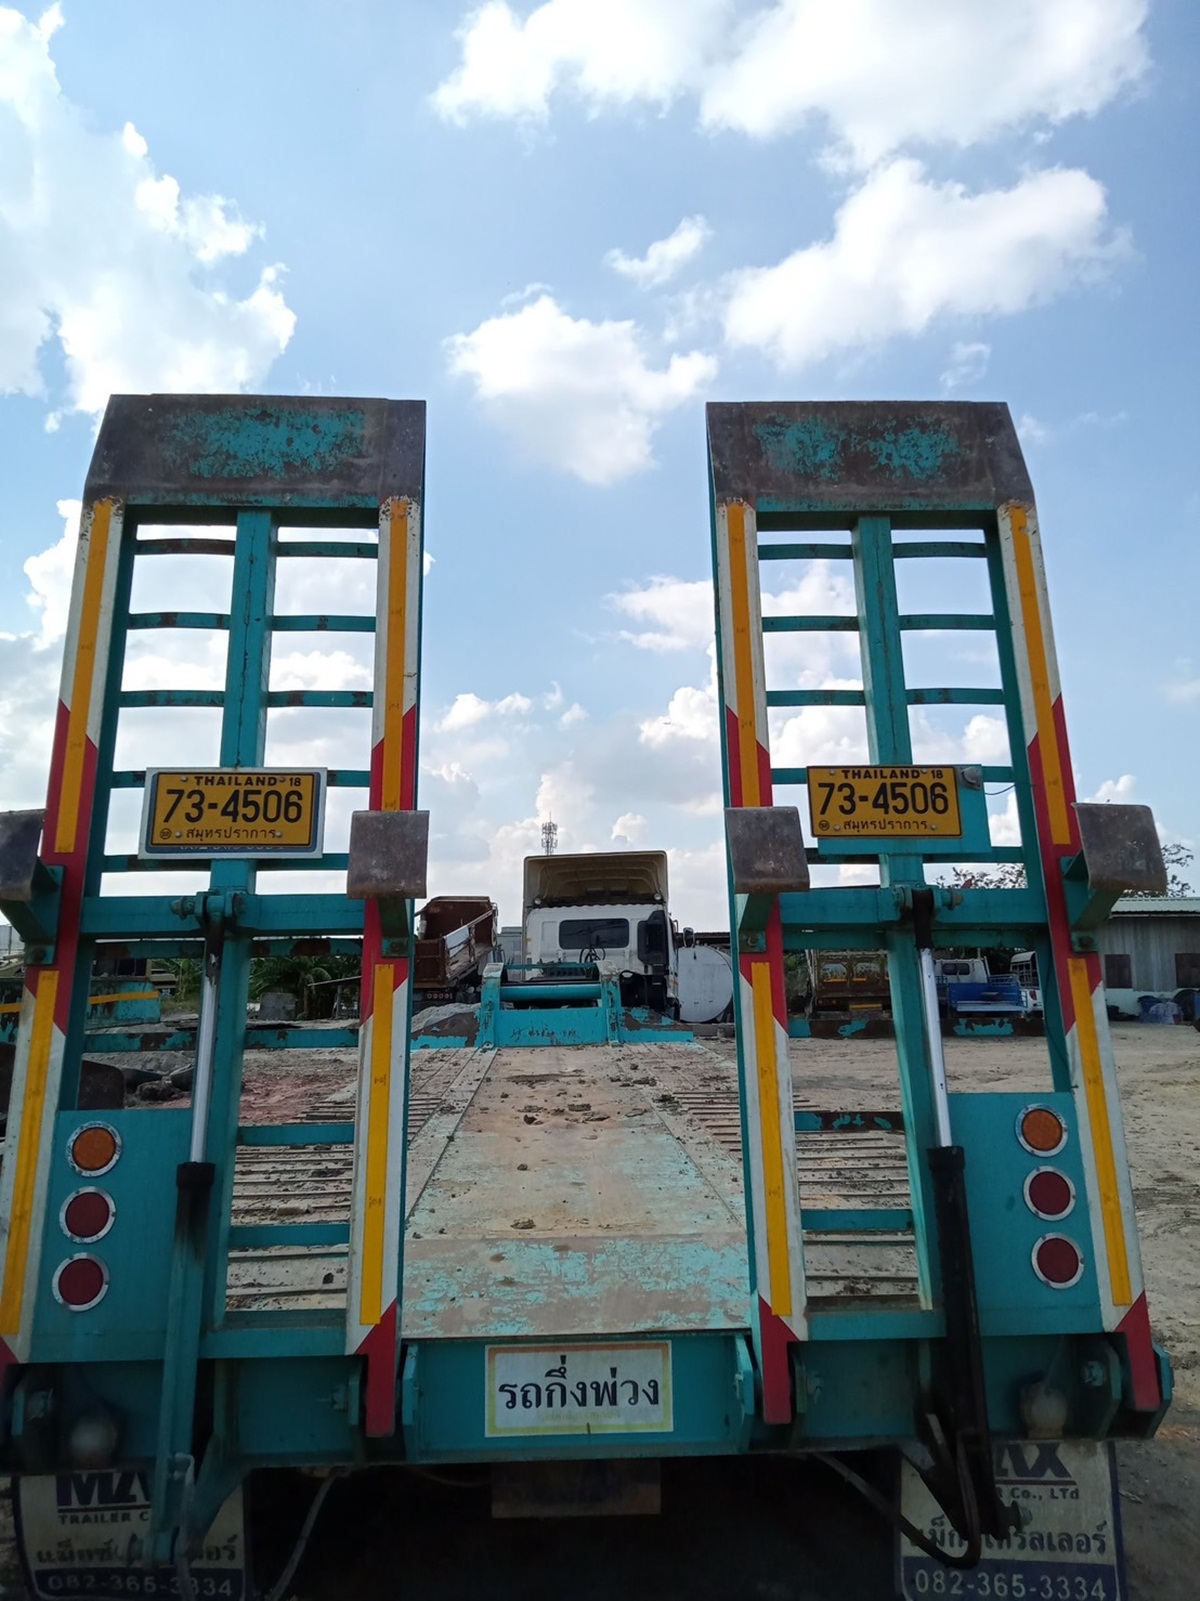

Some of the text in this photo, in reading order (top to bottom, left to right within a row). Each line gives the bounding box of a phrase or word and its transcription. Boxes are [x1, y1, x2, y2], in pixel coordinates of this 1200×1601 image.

[194, 775, 302, 787] THAILAND 18
[841, 769, 943, 779] THAILAND 18
[163, 789, 303, 823] 73-4506
[817, 782, 949, 815] 73-4506
[843, 819, 928, 832] สมุทรปราการ
[186, 826, 276, 842] สมุทรปราการ
[498, 1355, 660, 1410] รถกึ่งพ่วง
[58, 1512, 131, 1525] TRAILER
[914, 1569, 1107, 1600] 082-365-3334
